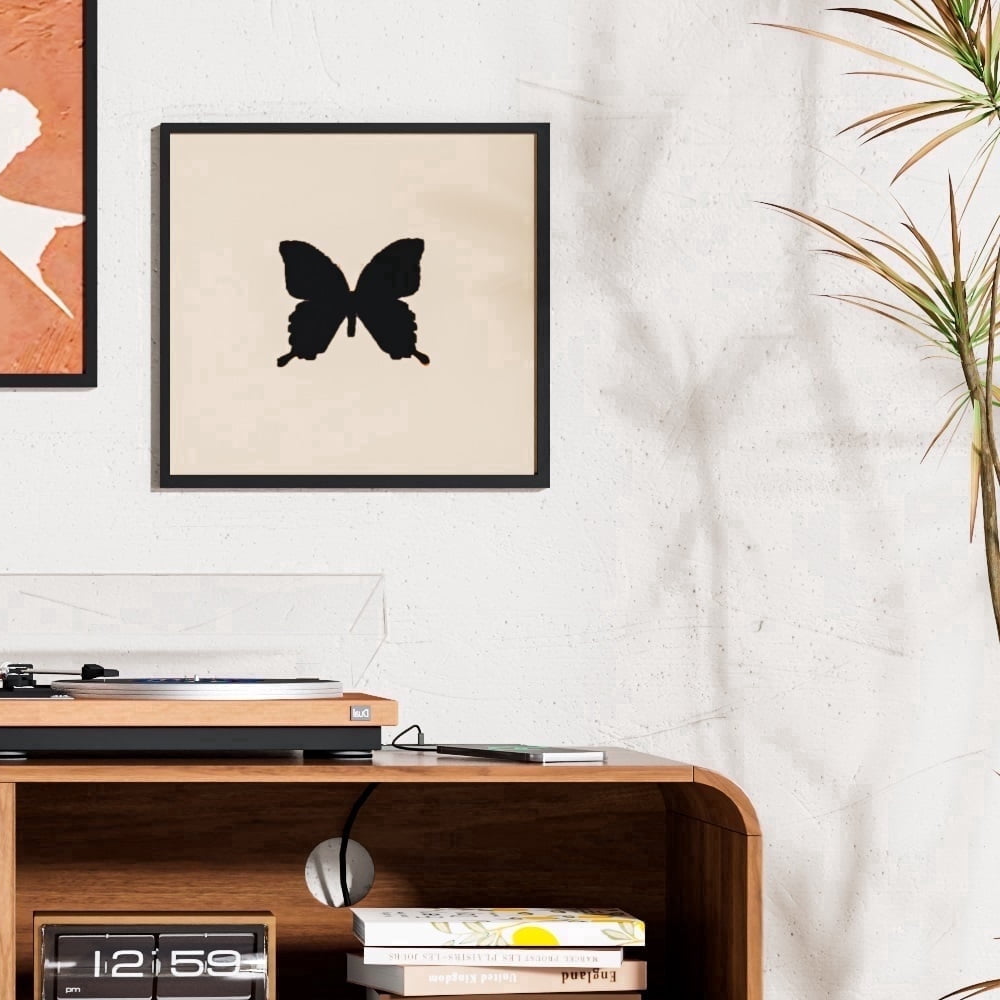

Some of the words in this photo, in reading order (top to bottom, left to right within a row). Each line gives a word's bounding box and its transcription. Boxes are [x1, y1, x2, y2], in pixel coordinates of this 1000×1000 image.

[428, 971, 477, 984] Kingdom
[481, 972, 517, 984] United
[561, 968, 617, 984] England
[65, 986, 81, 994] pm
